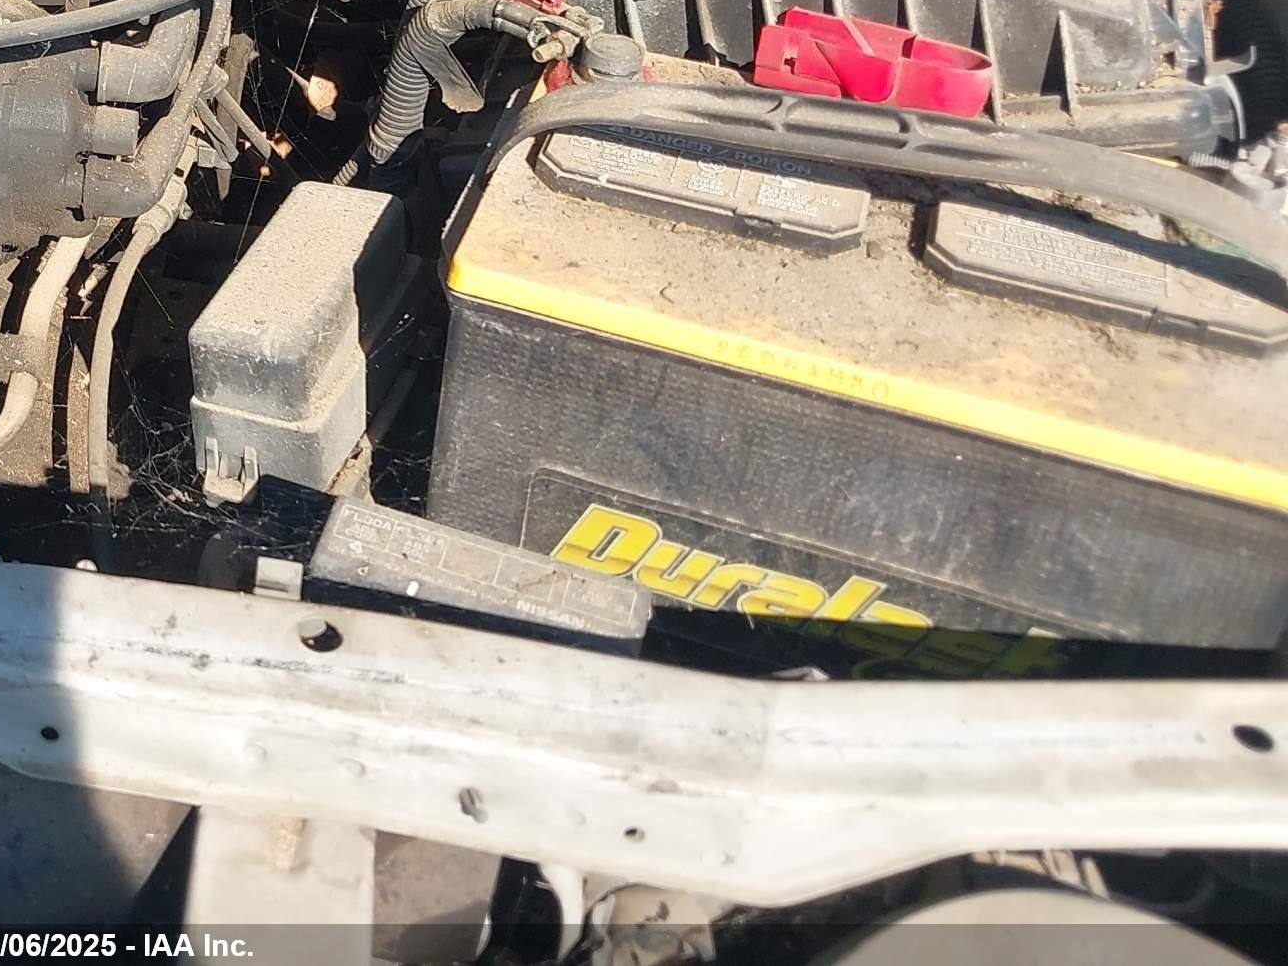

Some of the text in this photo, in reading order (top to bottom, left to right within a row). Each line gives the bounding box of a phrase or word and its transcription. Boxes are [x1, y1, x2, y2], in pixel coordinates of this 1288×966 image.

[635, 129, 713, 153] DANGER
[734, 151, 813, 176] POISON
[516, 600, 584, 628] NISSAN
